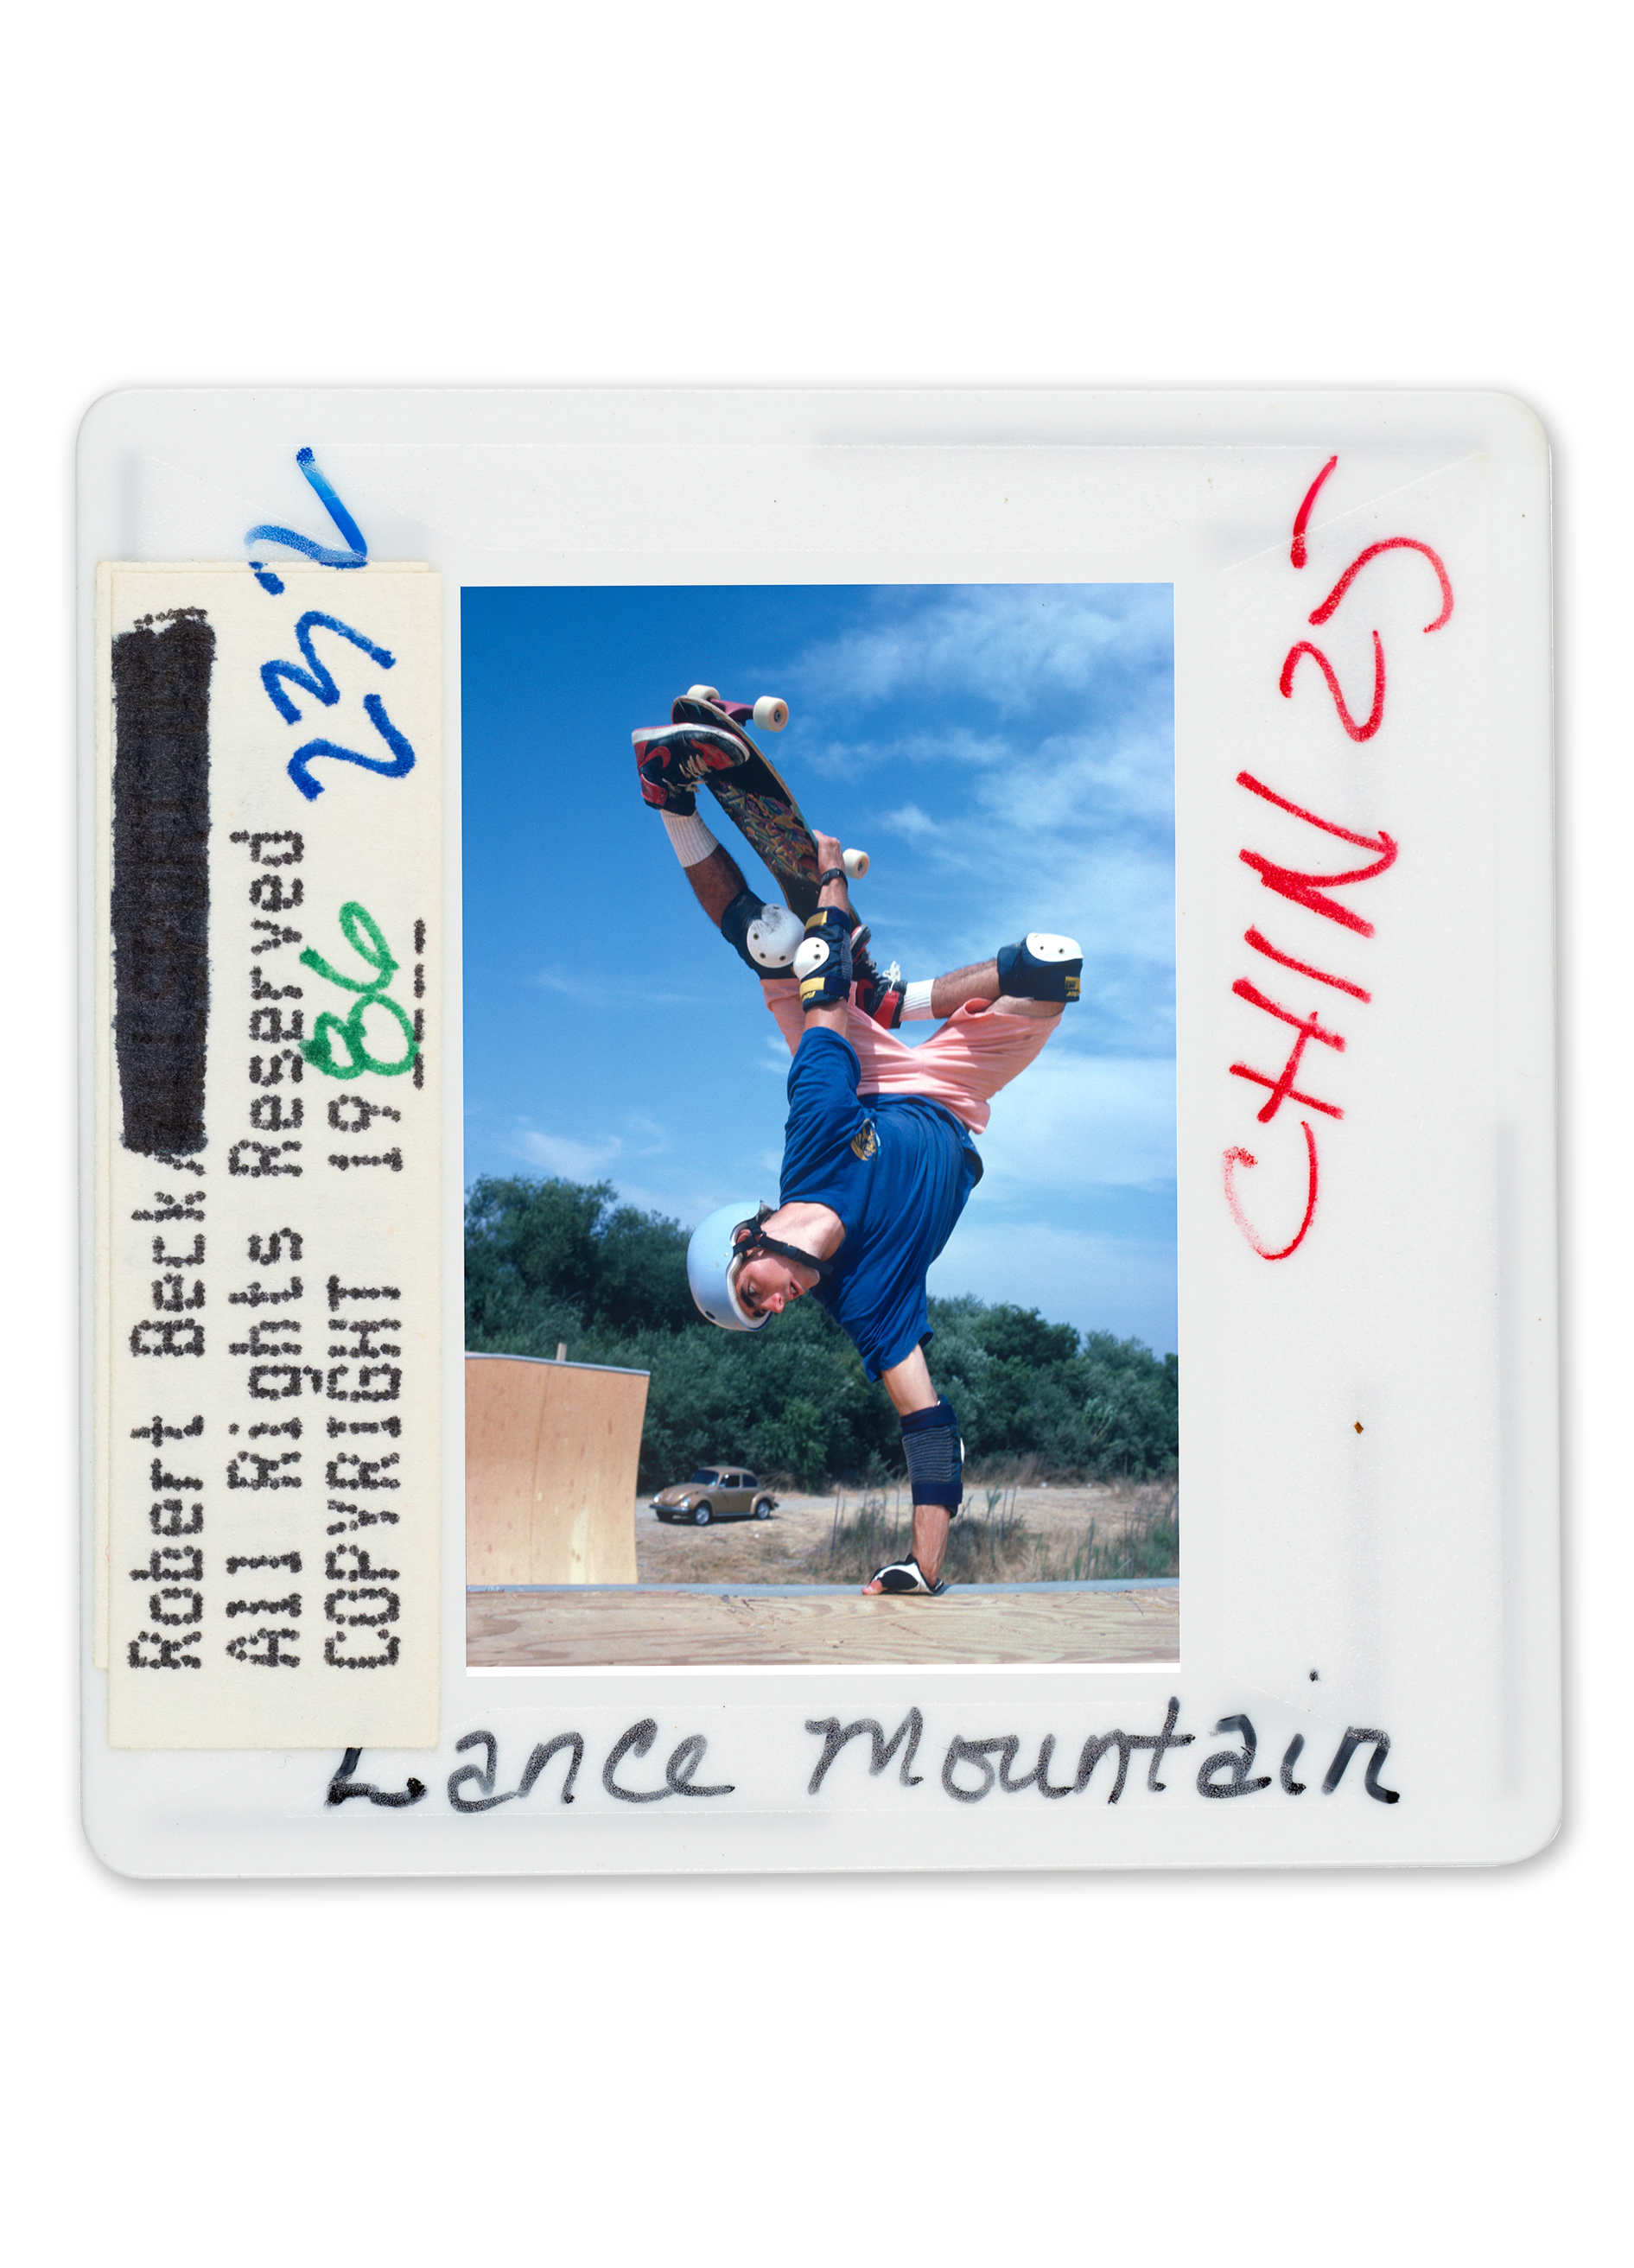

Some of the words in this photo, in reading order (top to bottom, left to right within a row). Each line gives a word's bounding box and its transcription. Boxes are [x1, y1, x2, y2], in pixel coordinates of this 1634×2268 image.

[246, 447, 416, 802] 232
[1279, 455, 1453, 742] 25
[228, 830, 304, 1178] Reserved
[1225, 771, 1398, 1261] CHIN
[226, 1228, 322, 1489] Rights
[325, 1274, 403, 1669] COPYRIGHT
[129, 1414, 204, 1669] Robert
[226, 1550, 302, 1668] All
[325, 1718, 734, 1814] Lance
[805, 1696, 1400, 1805] Mountain
